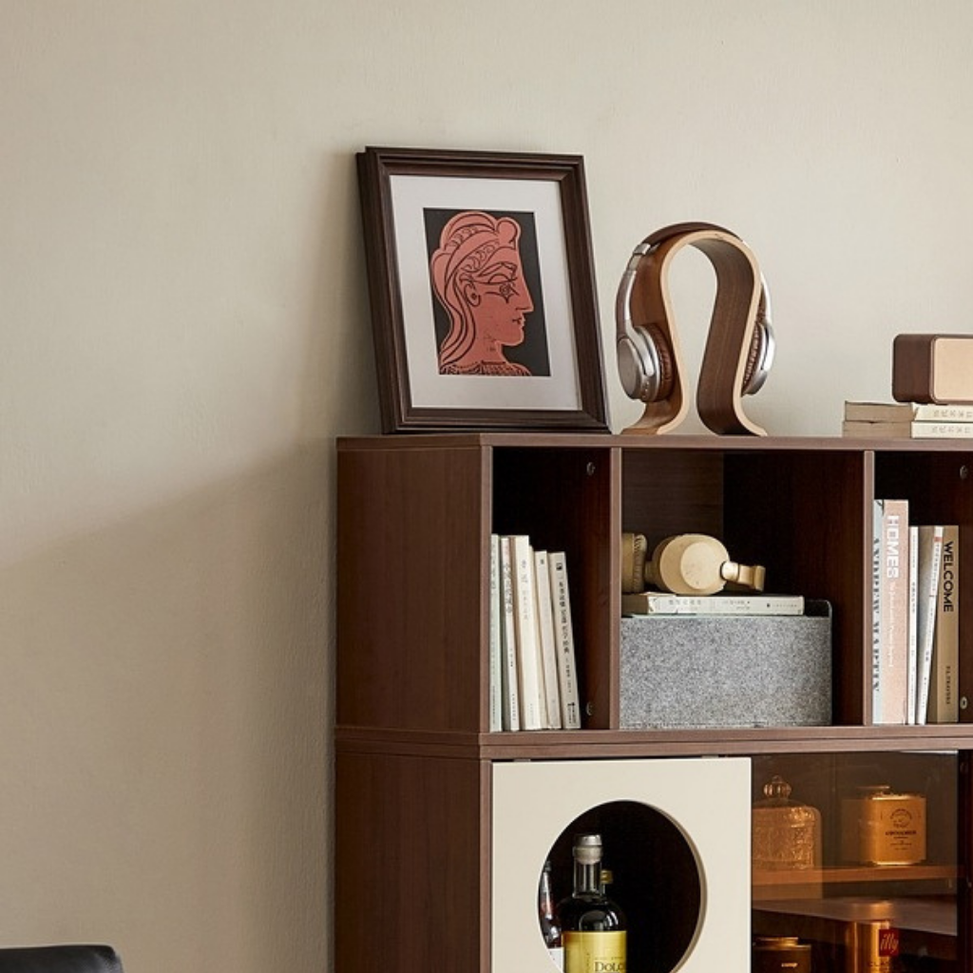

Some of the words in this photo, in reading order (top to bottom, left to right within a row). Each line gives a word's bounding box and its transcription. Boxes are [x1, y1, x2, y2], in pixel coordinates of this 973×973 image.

[886, 515, 900, 578] HOMES
[943, 541, 954, 612] WELCOME
[880, 932, 899, 954] illy
